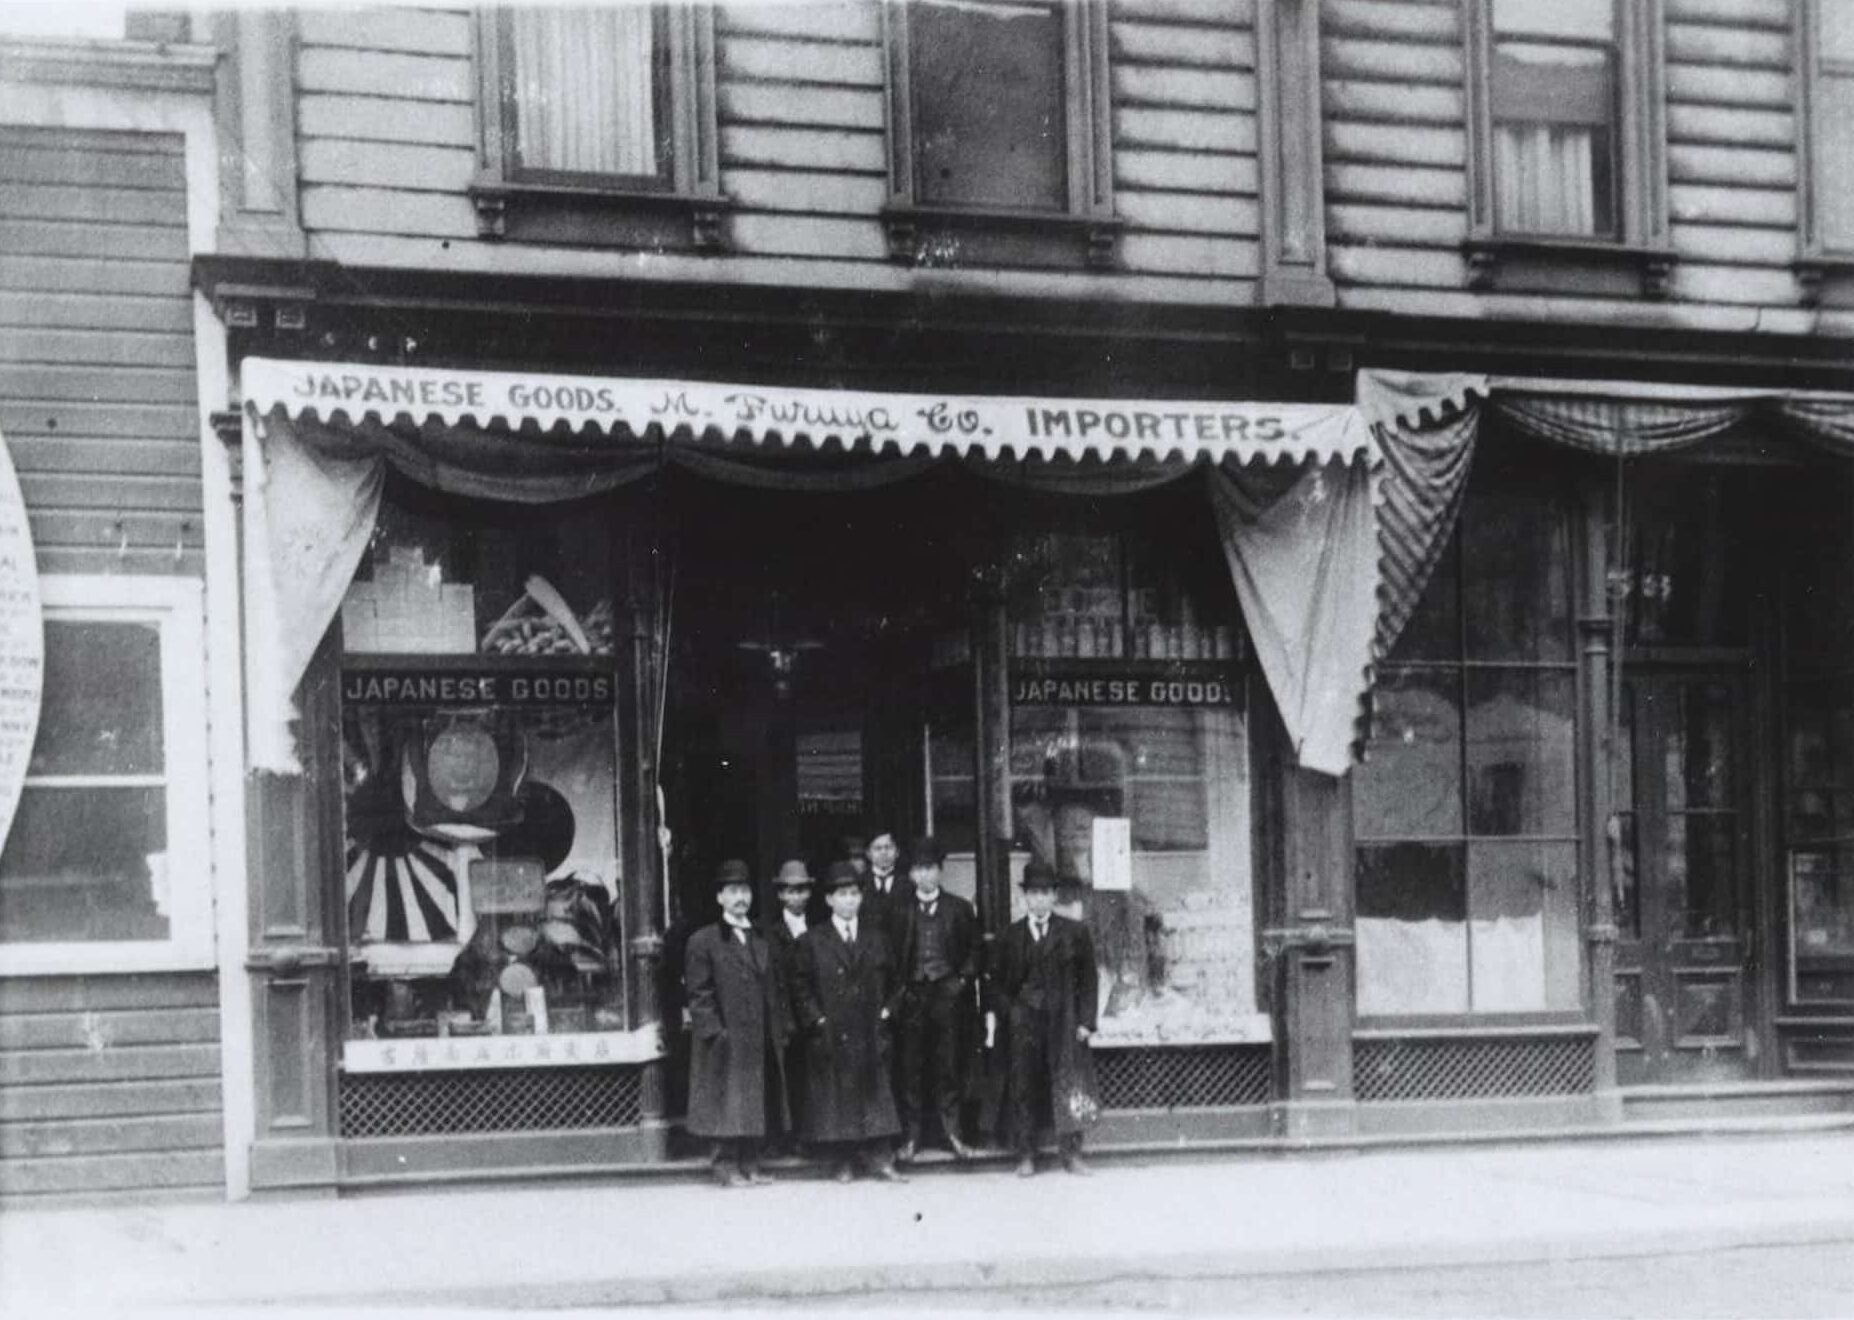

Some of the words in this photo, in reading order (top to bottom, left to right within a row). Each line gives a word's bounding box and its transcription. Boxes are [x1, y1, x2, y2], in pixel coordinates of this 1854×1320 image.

[293, 375, 485, 406] JAPANESE
[508, 384, 622, 412] GOODS.
[651, 391, 712, 417] M.
[916, 401, 994, 435] Co.
[1026, 407, 1300, 441] IMPORTERS.
[347, 677, 496, 699] JAPANESE
[512, 678, 608, 699] GOODS
[1017, 680, 1141, 701] JAPANESE
